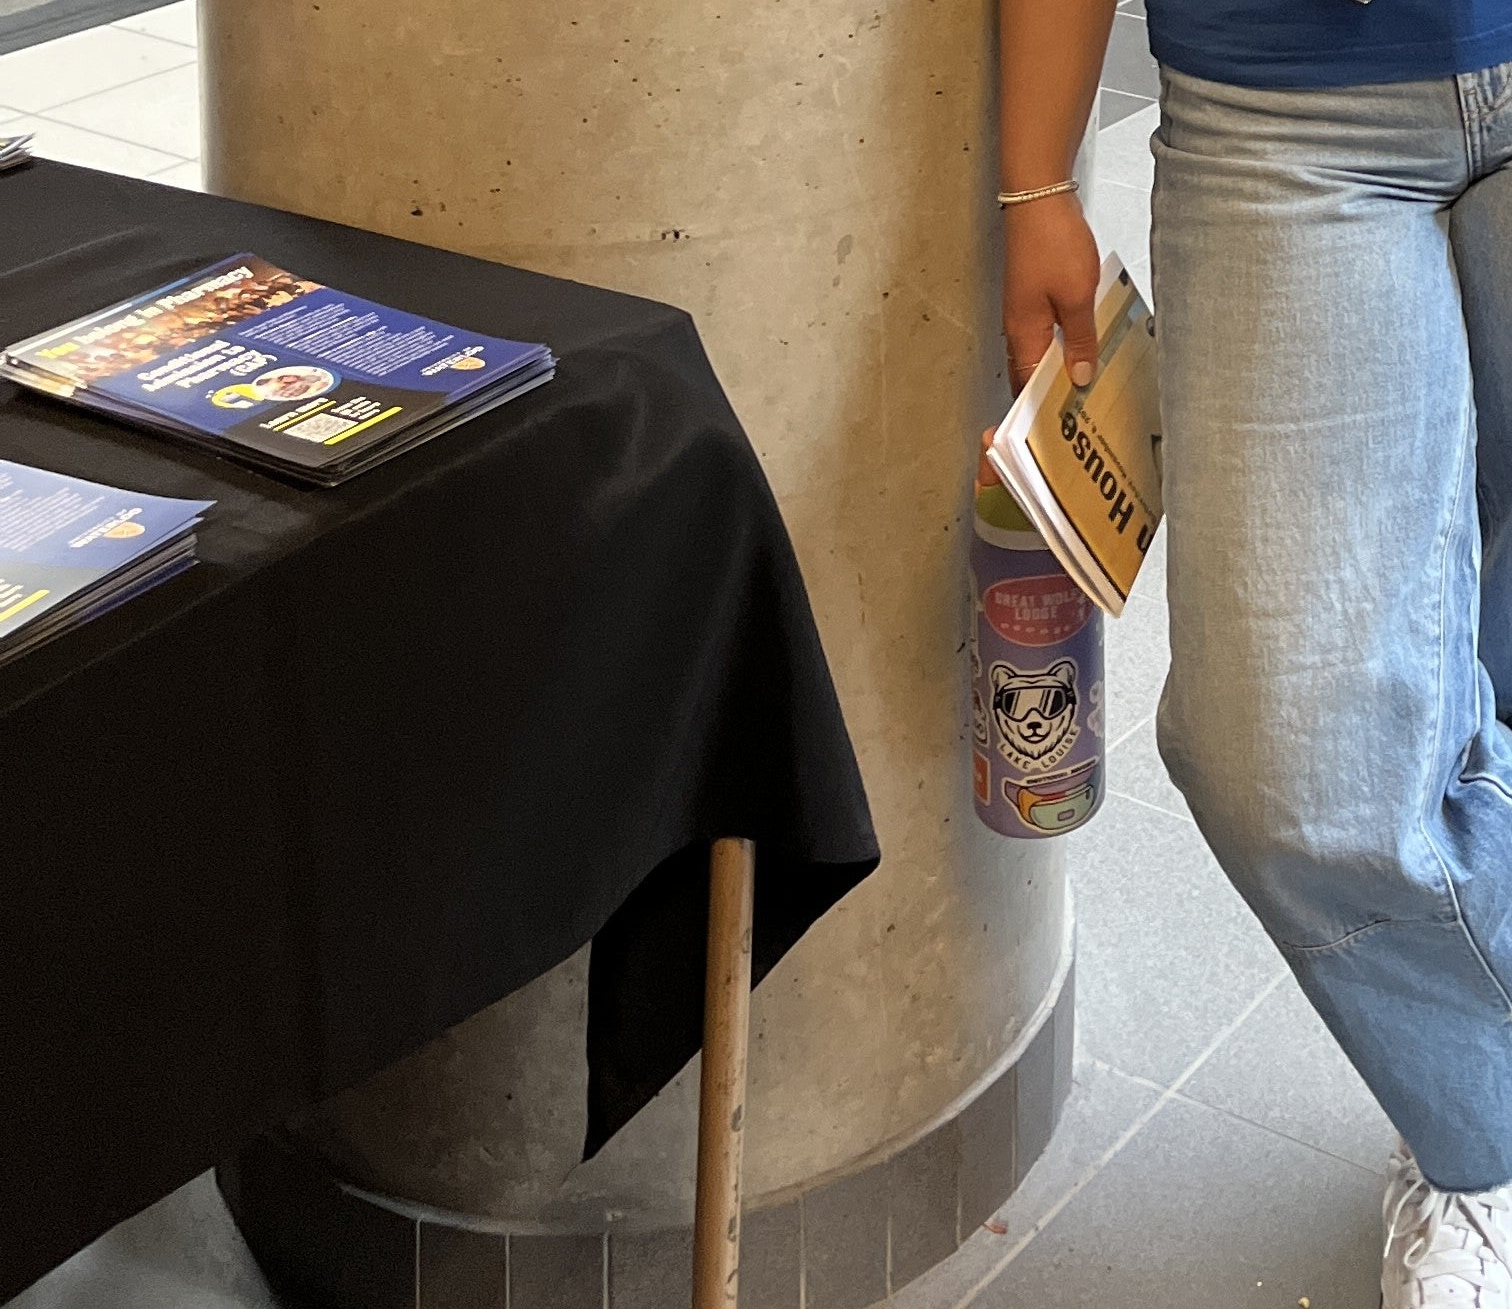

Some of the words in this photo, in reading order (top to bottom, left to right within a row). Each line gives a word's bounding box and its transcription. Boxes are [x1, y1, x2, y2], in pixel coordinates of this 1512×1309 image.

[156, 266, 254, 310] Pharmacy
[1061, 412, 1135, 534] House
[1000, 743, 1031, 769] LAKE
[1041, 727, 1078, 769] LOUISE
